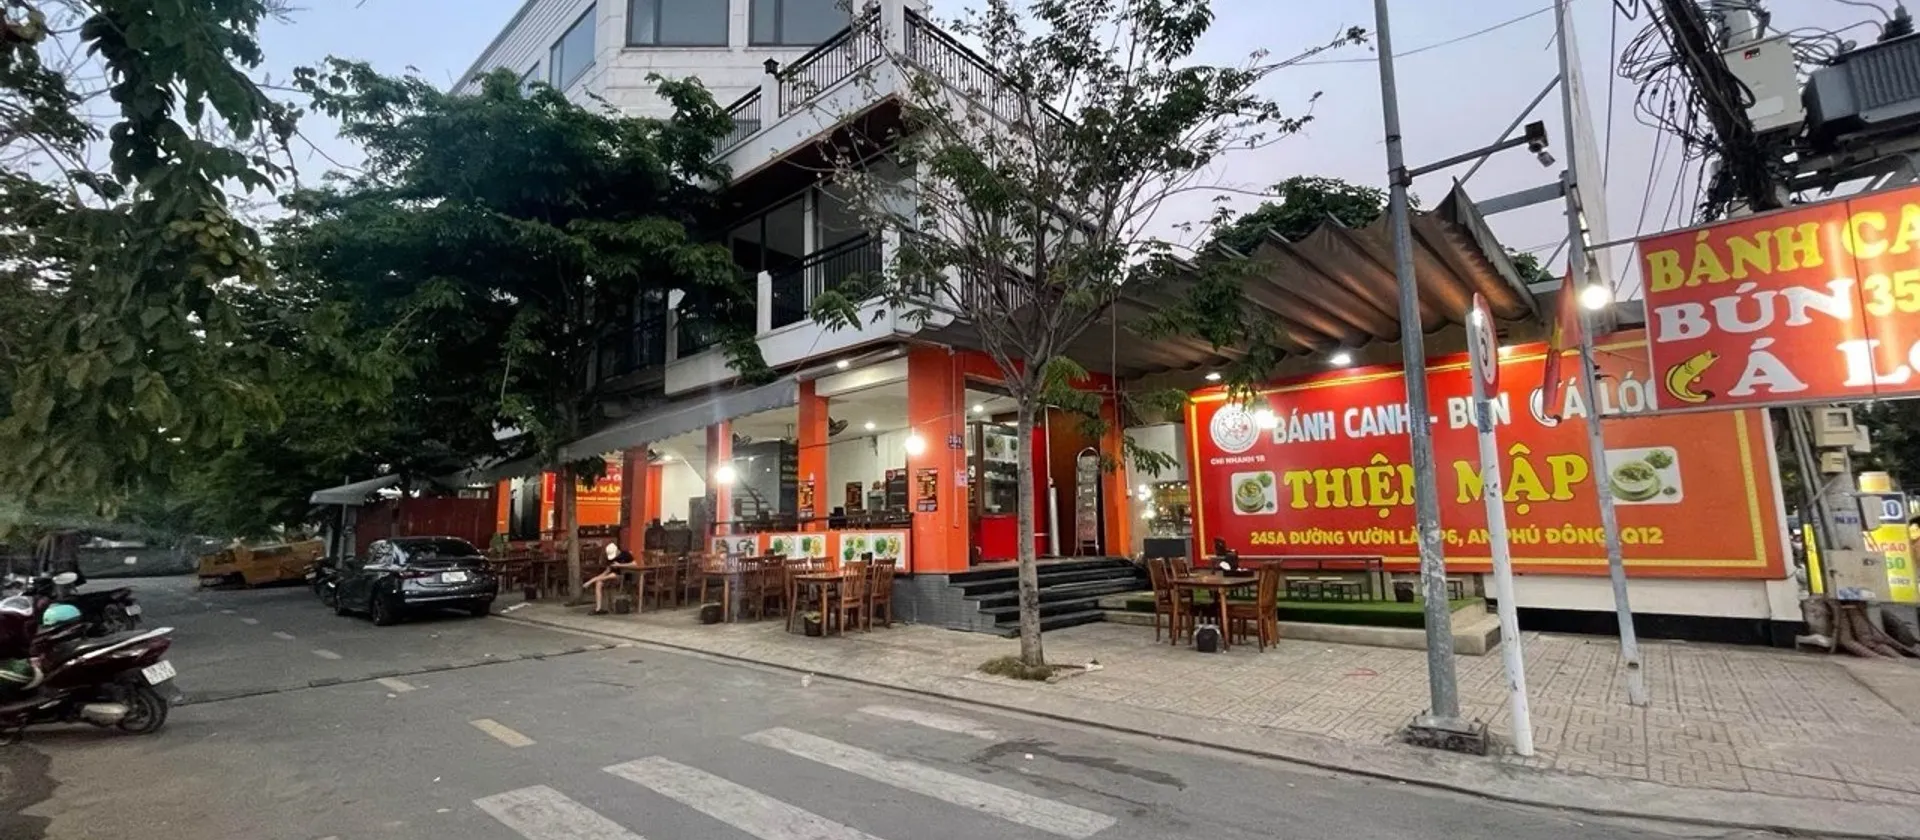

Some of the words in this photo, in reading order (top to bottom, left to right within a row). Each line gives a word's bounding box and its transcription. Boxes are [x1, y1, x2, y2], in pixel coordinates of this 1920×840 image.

[1646, 222, 1824, 293] BÁNH
[1654, 279, 1856, 342] BÚN
[1272, 408, 1336, 444] BÁNH
[1250, 531, 1287, 545] 245A
[1290, 527, 1345, 545] ĐƯỜNG
[1347, 526, 1396, 545] VƯỜN
